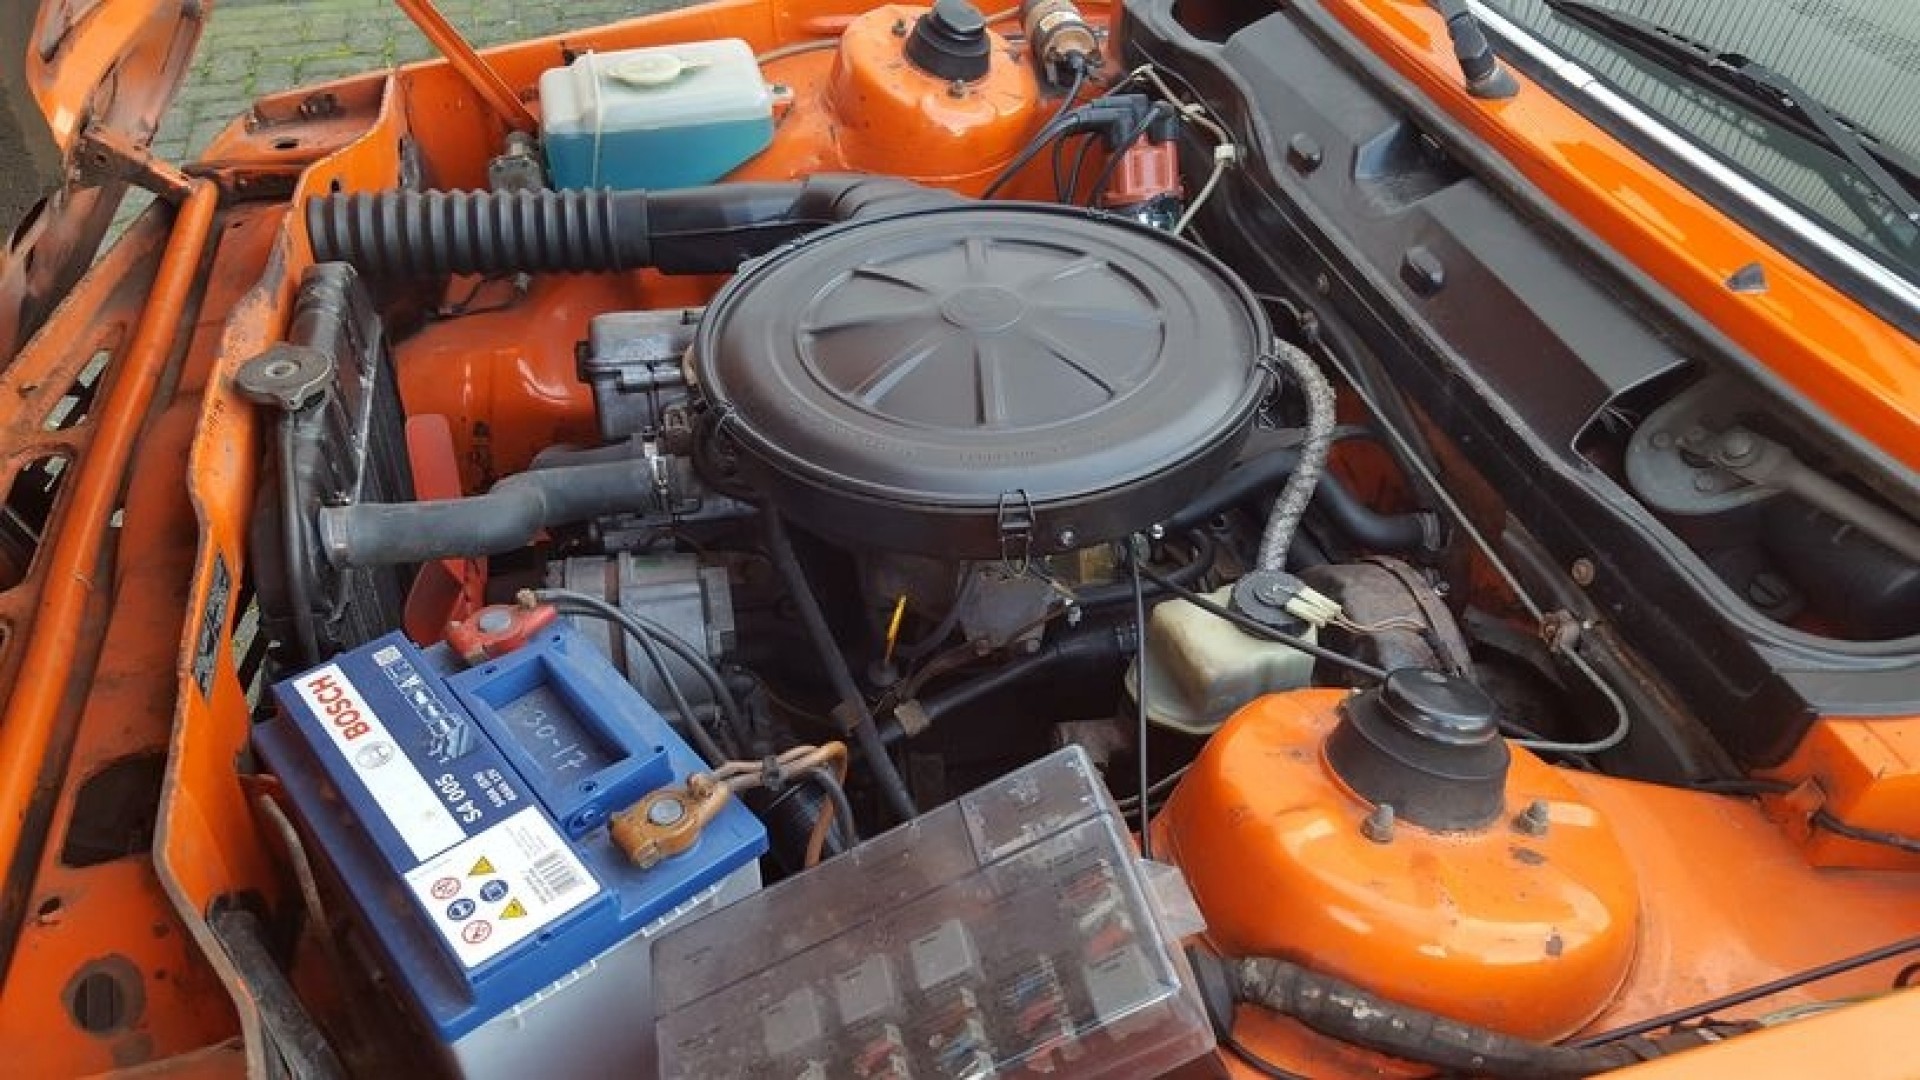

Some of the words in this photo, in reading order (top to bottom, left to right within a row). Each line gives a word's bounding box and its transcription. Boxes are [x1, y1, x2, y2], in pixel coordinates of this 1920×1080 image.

[308, 675, 371, 741] BOSCH
[435, 773, 467, 802] 005
[456, 799, 482, 823] S4
